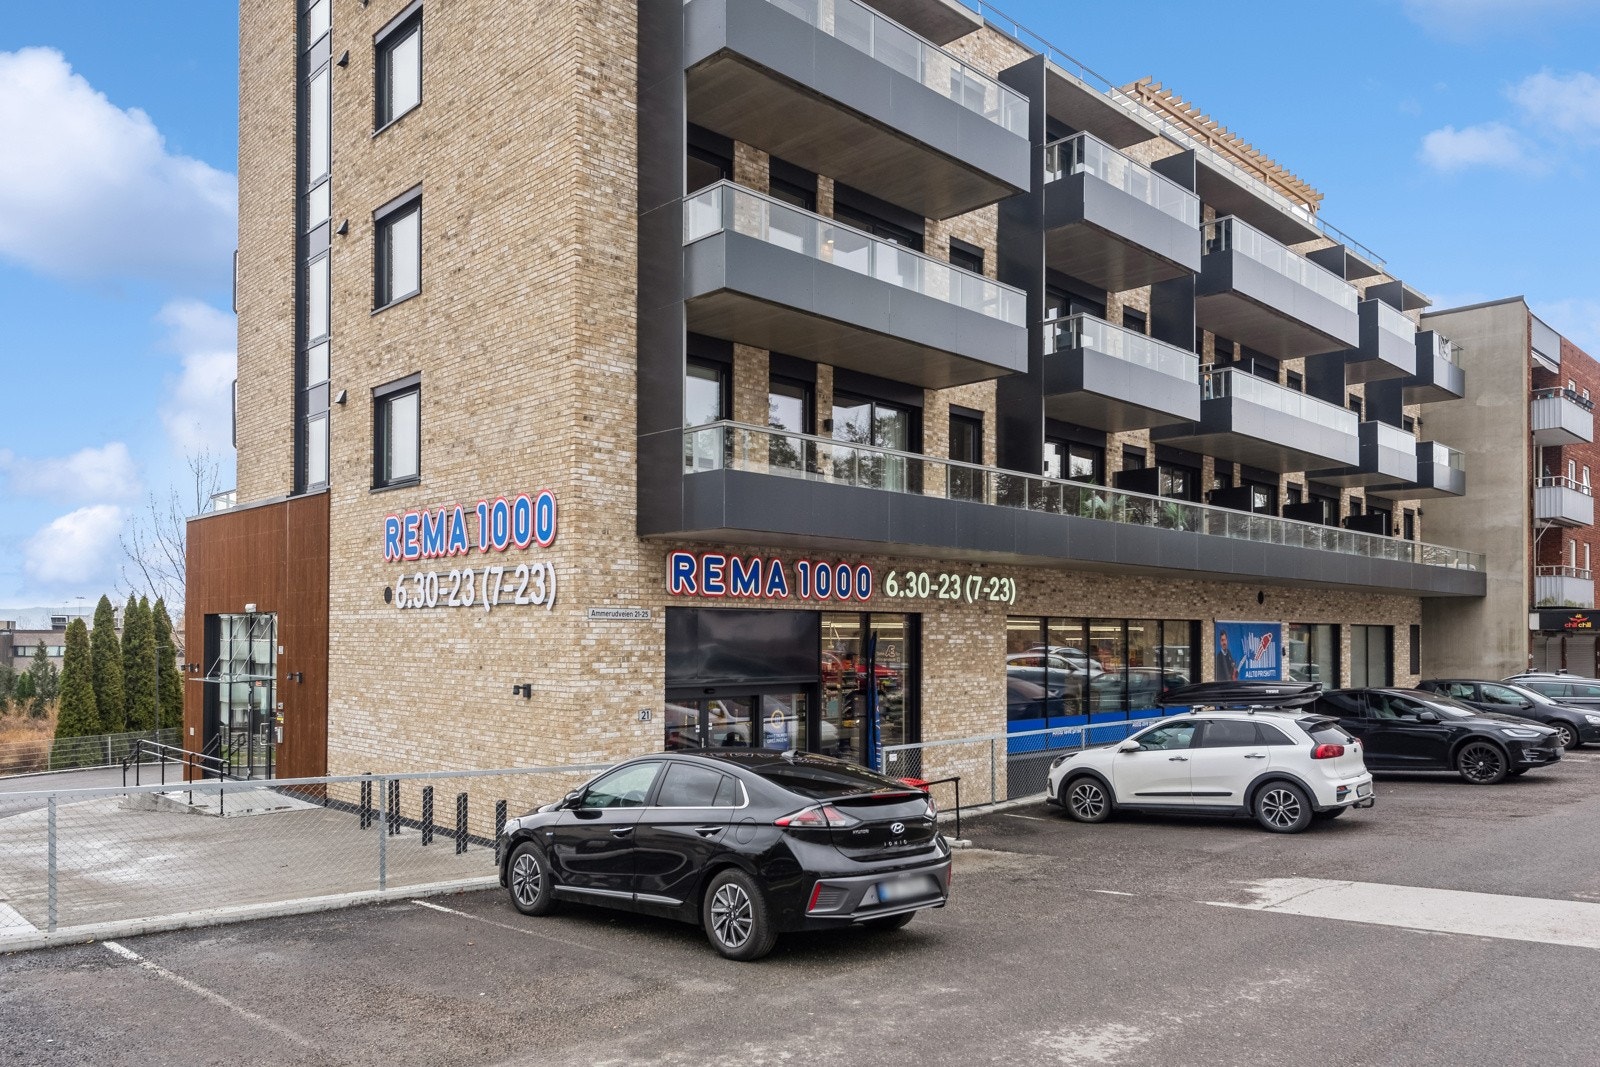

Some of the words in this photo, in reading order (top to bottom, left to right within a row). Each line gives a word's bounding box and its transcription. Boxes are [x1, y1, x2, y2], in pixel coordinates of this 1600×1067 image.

[384, 503, 469, 563] REMA
[476, 489, 558, 553] 1000
[395, 568, 475, 609] 6.30-23
[482, 561, 557, 612] (7-23)
[667, 549, 789, 600] REMA
[795, 558, 874, 602] 1000
[885, 570, 961, 599] 6.30-23
[965, 574, 1016, 606] (7-23)
[591, 609, 634, 618] Ammerudveien
[634, 610, 649, 618] 21-25
[641, 710, 650, 720] 21
